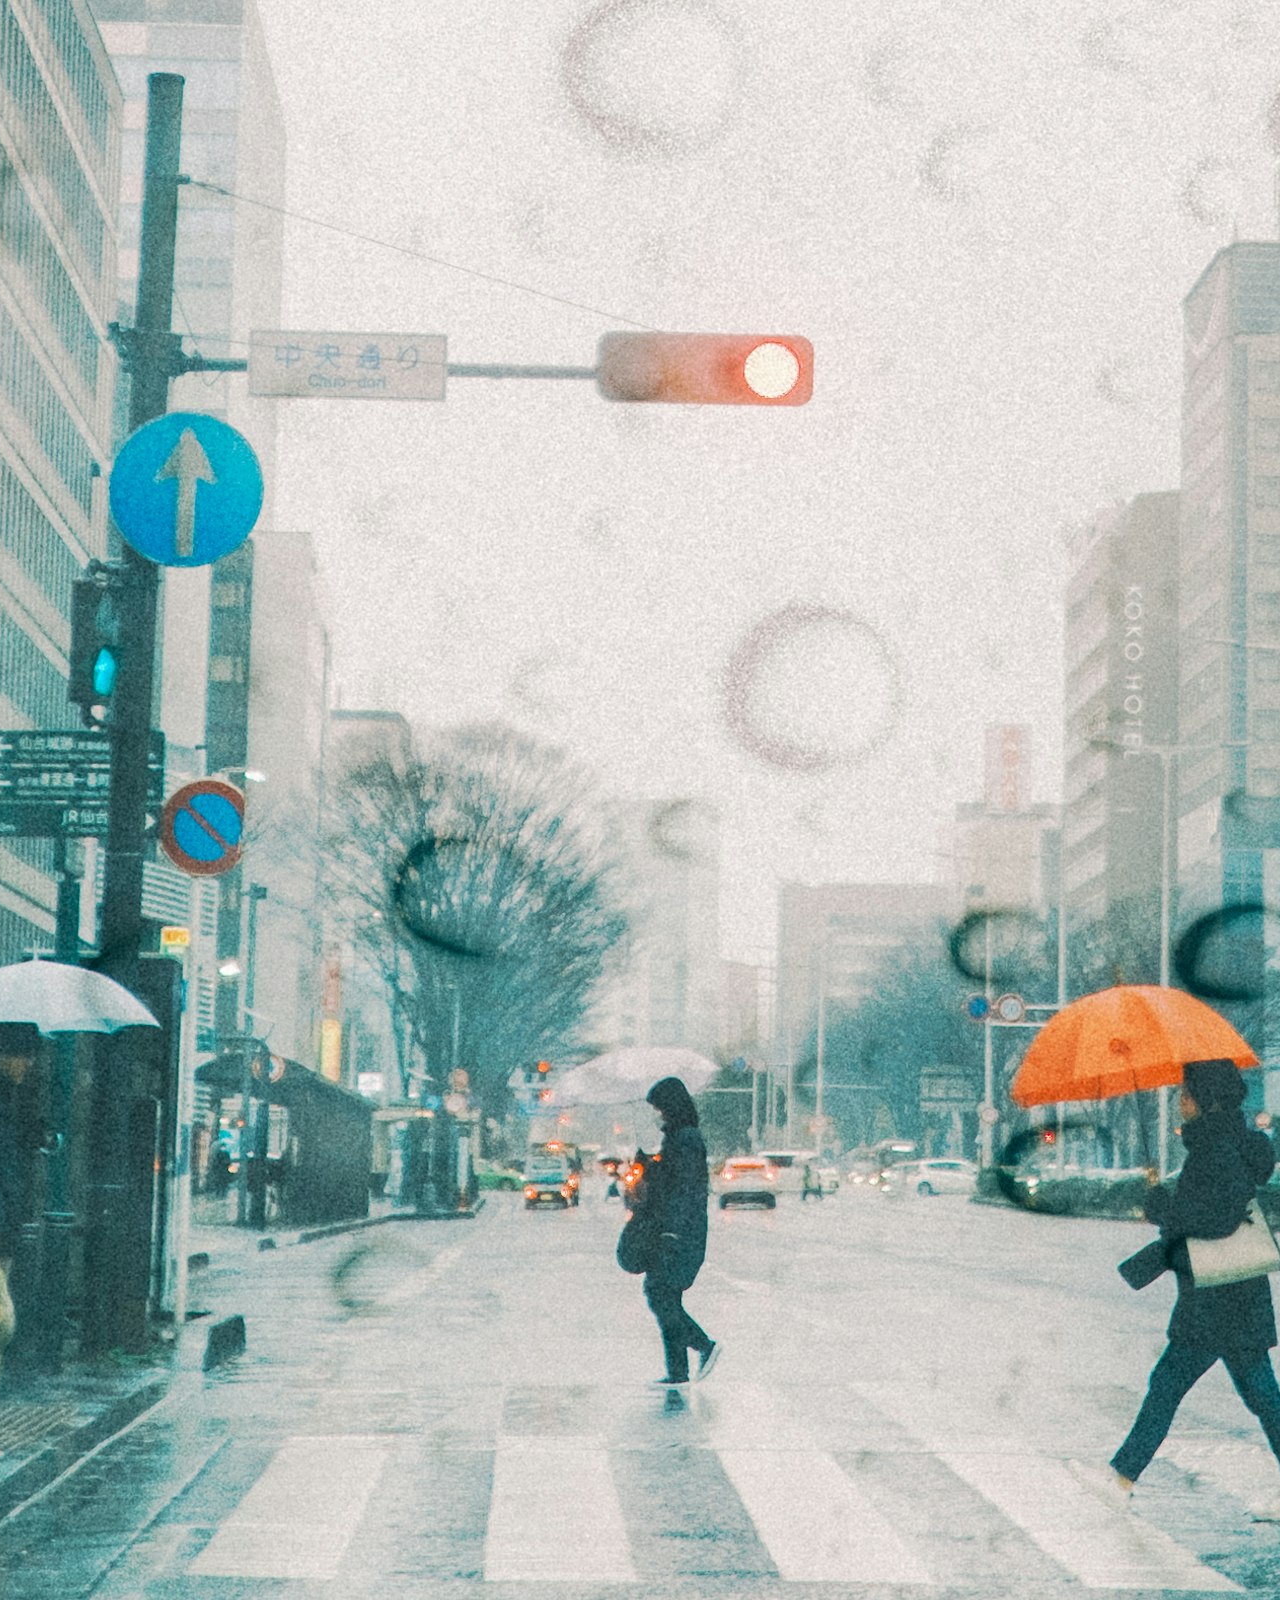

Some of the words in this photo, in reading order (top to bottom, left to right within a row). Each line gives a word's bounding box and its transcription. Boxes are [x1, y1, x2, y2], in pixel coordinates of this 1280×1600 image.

[275, 343, 419, 370] 中央通り
[1123, 586, 1143, 661] KOKO
[1123, 675, 1143, 759] HOTEL
